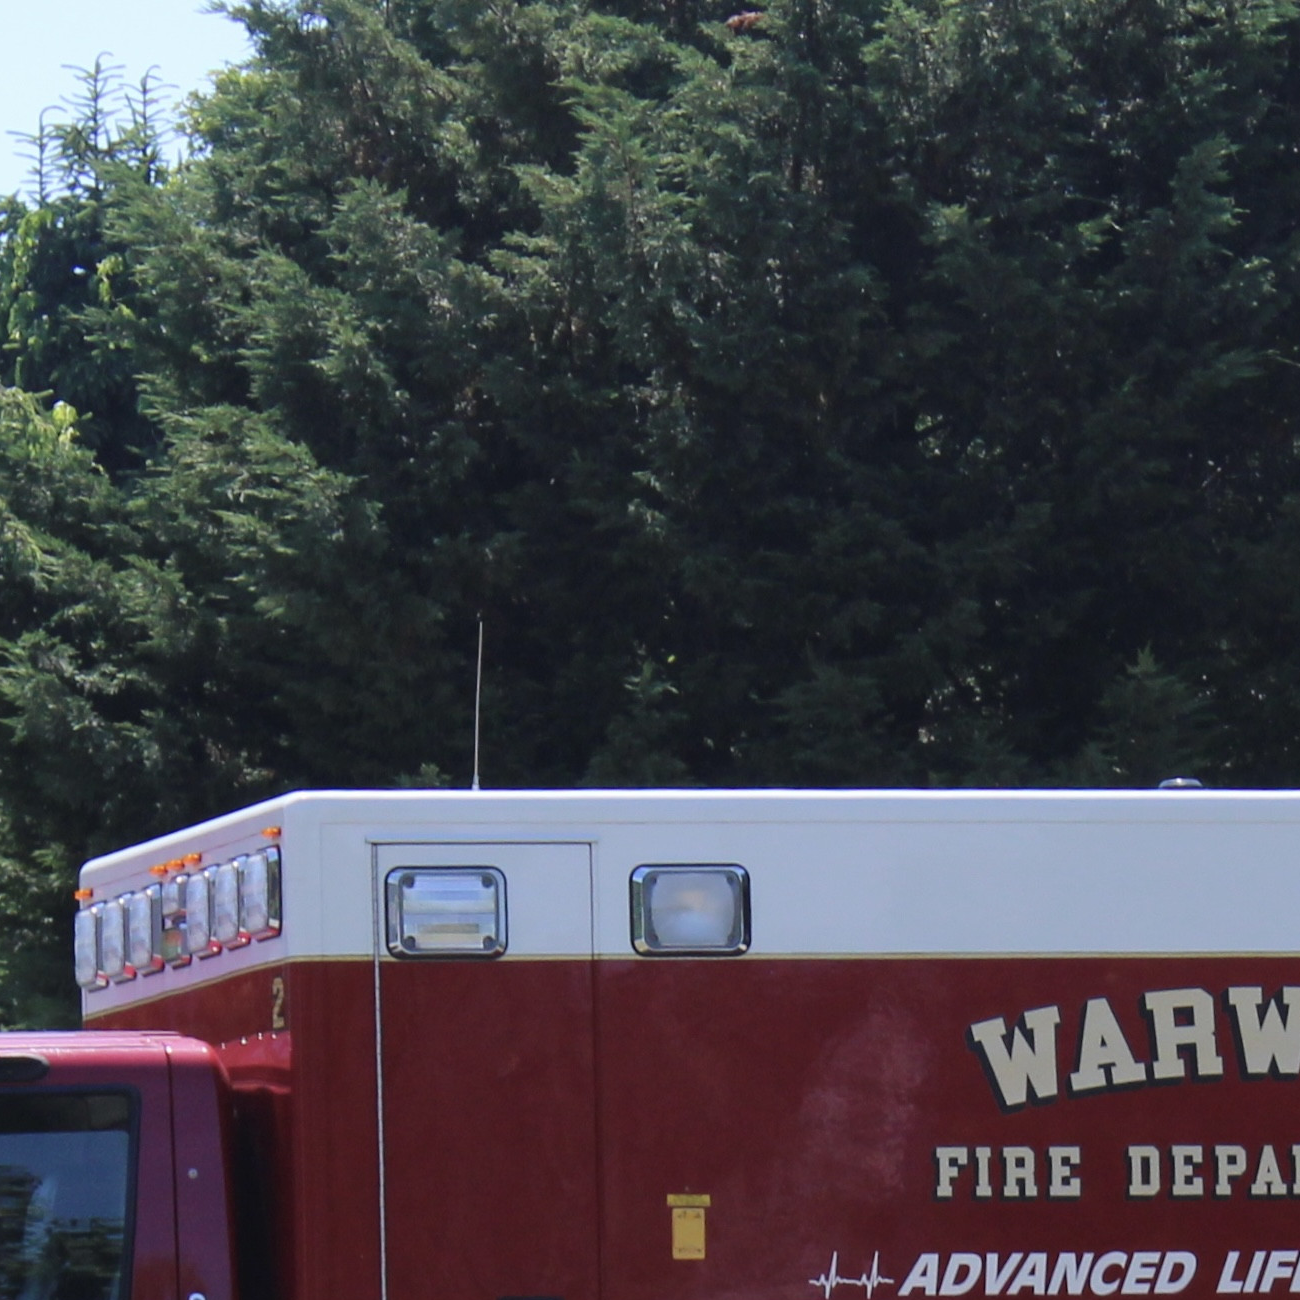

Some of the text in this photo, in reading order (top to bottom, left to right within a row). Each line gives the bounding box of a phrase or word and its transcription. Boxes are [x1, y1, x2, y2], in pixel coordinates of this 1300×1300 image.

[272, 976, 285, 1029] 2
[934, 1146, 1083, 1199] FIRE
[899, 1251, 1197, 1296] ADVANCED
